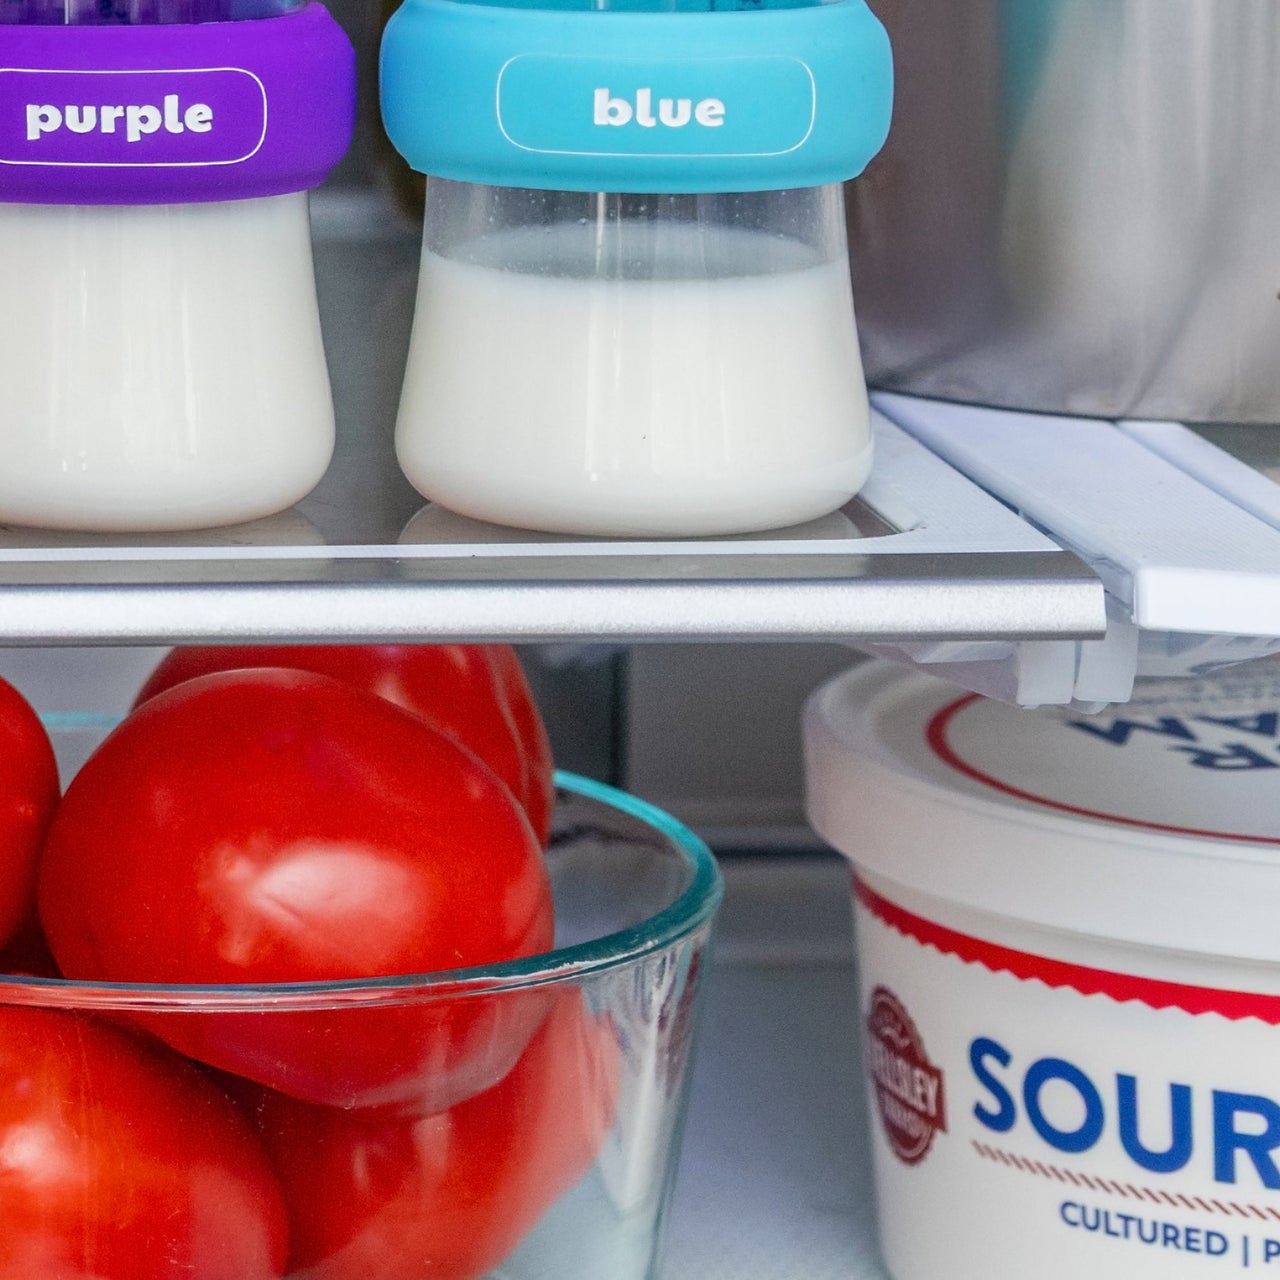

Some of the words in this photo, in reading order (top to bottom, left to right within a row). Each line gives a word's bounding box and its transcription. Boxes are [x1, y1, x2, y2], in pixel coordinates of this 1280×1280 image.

[26, 94, 213, 142] purple
[594, 88, 726, 128] blue
[969, 1036, 1280, 1191] SOUR
[1060, 1201, 1229, 1256] CULTURED
